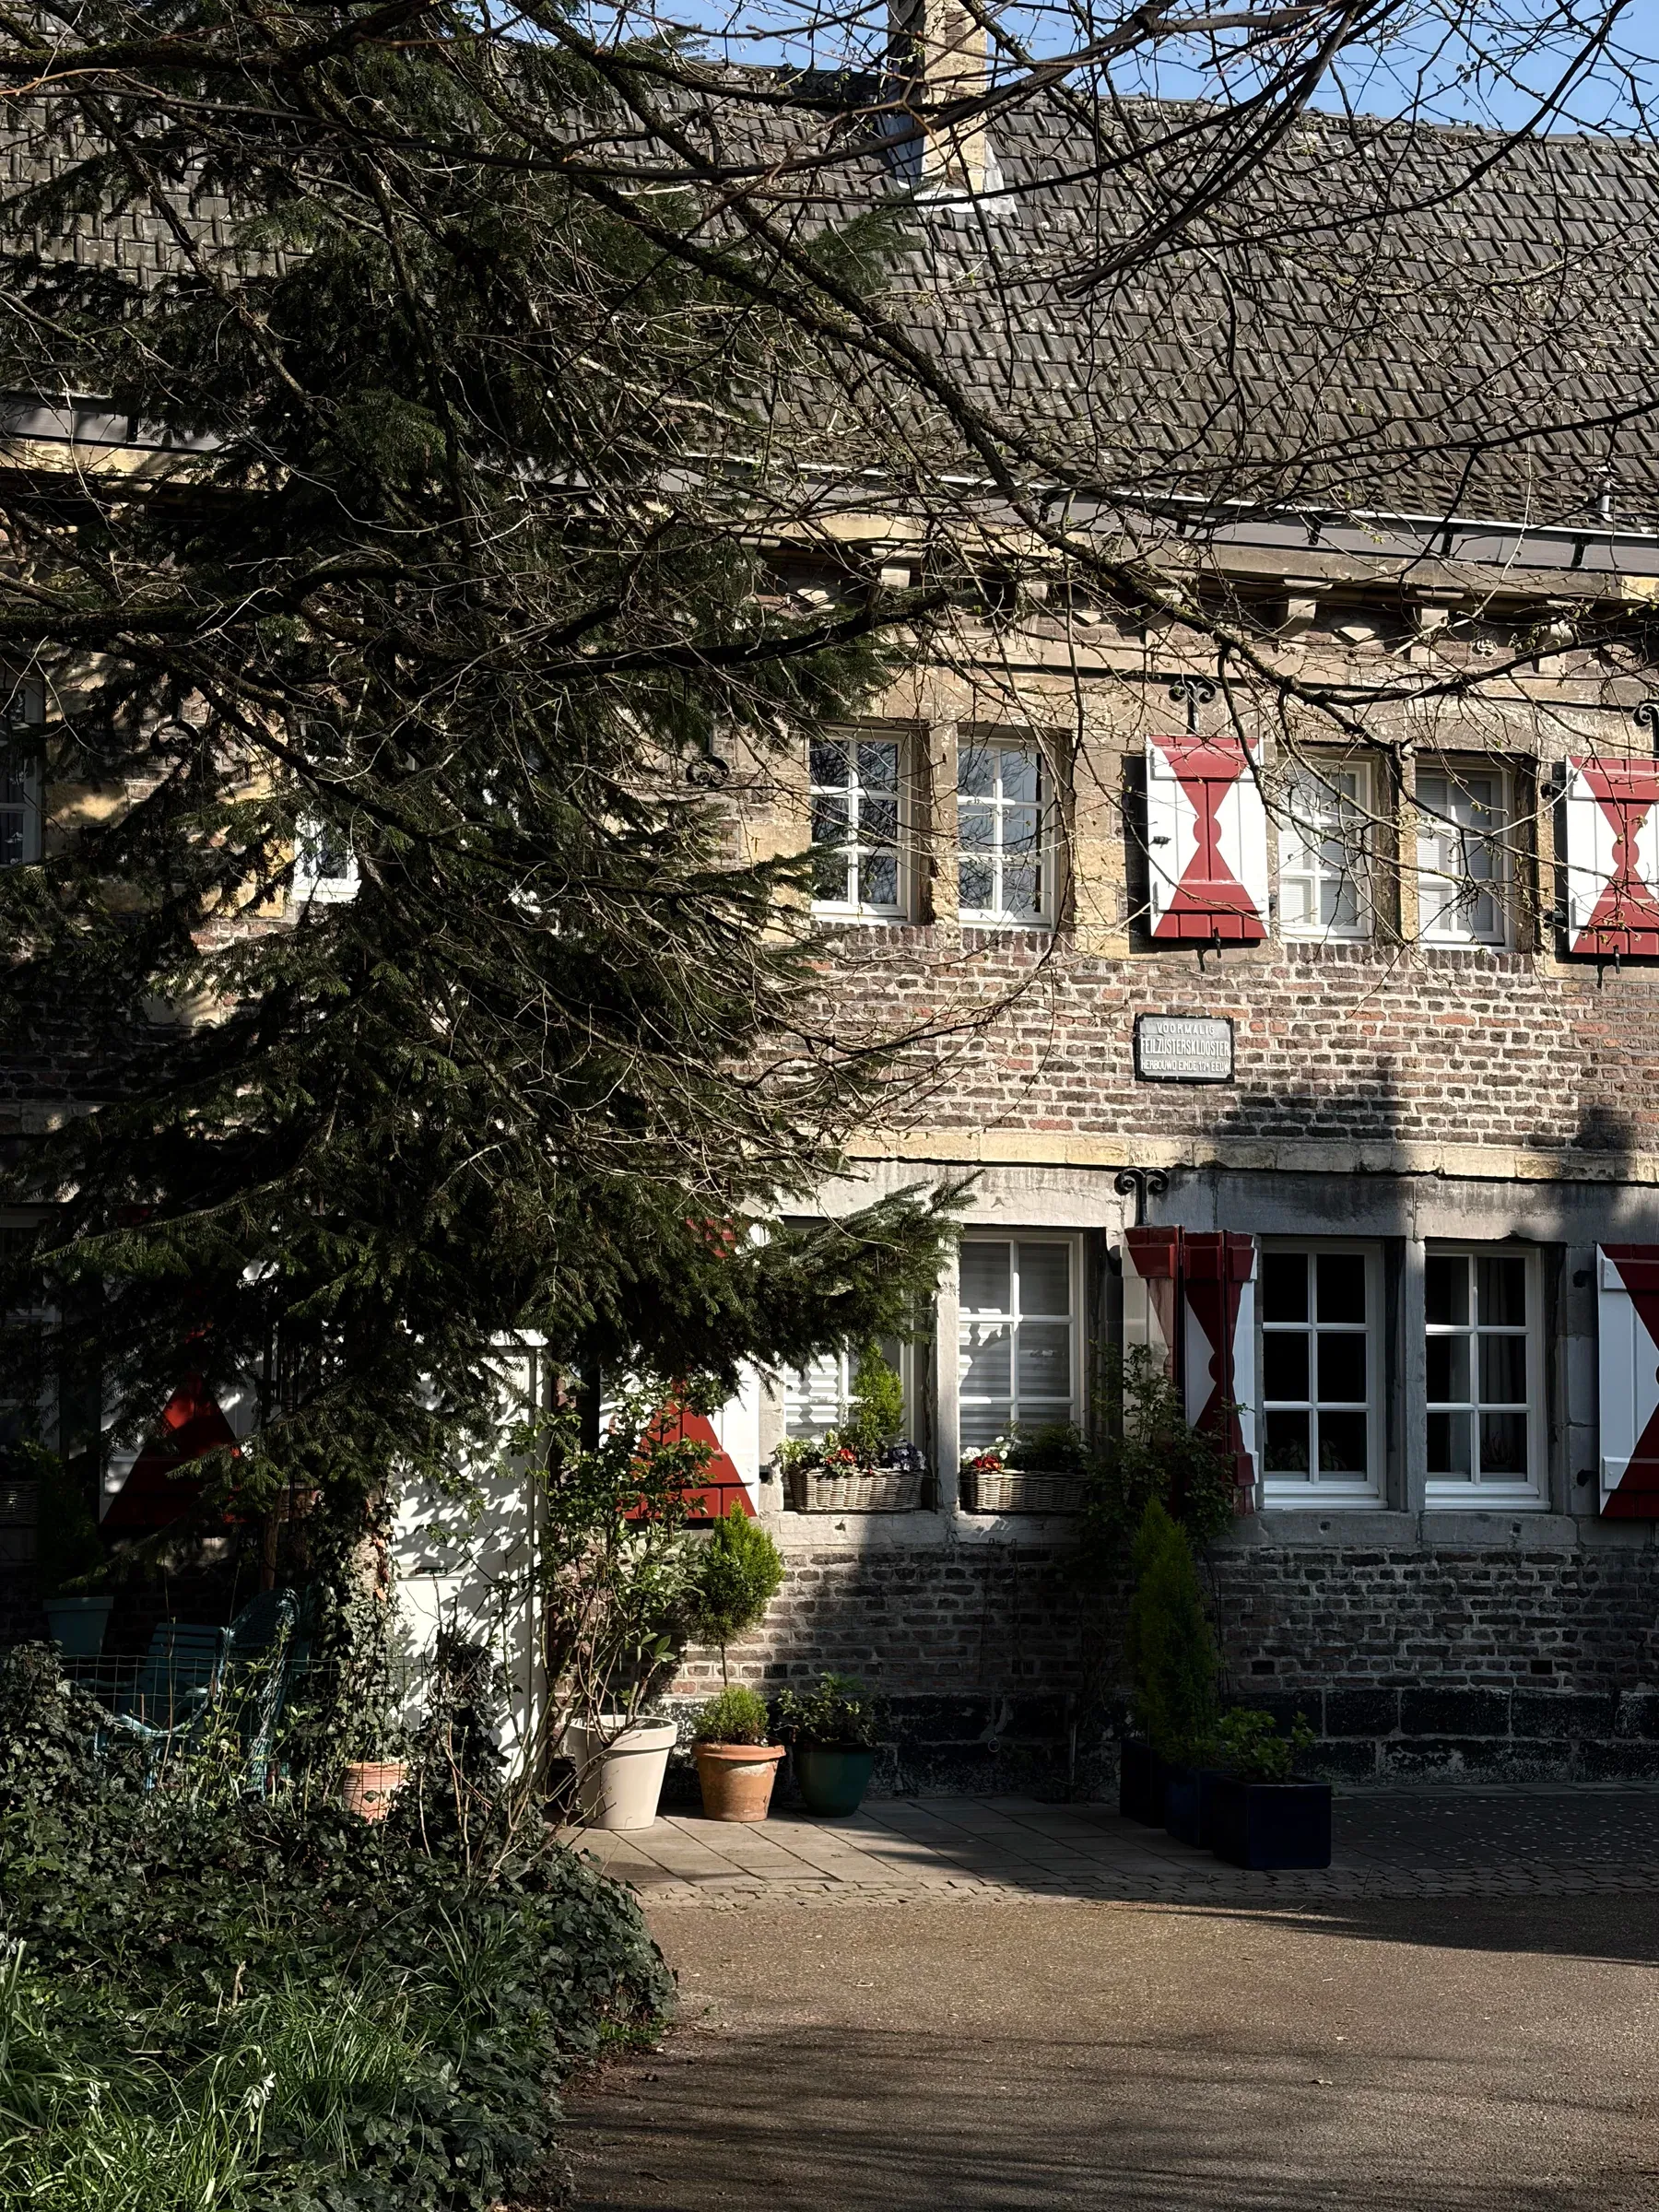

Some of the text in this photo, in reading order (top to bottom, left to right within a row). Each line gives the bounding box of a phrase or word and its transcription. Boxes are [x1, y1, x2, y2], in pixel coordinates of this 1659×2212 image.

[1157, 1023, 1215, 1035] VOORMALIG
[1141, 1059, 1176, 1070] HERBOUWD
[1179, 1061, 1196, 1071] EINDE
[1211, 1062, 1230, 1072] EEUW
